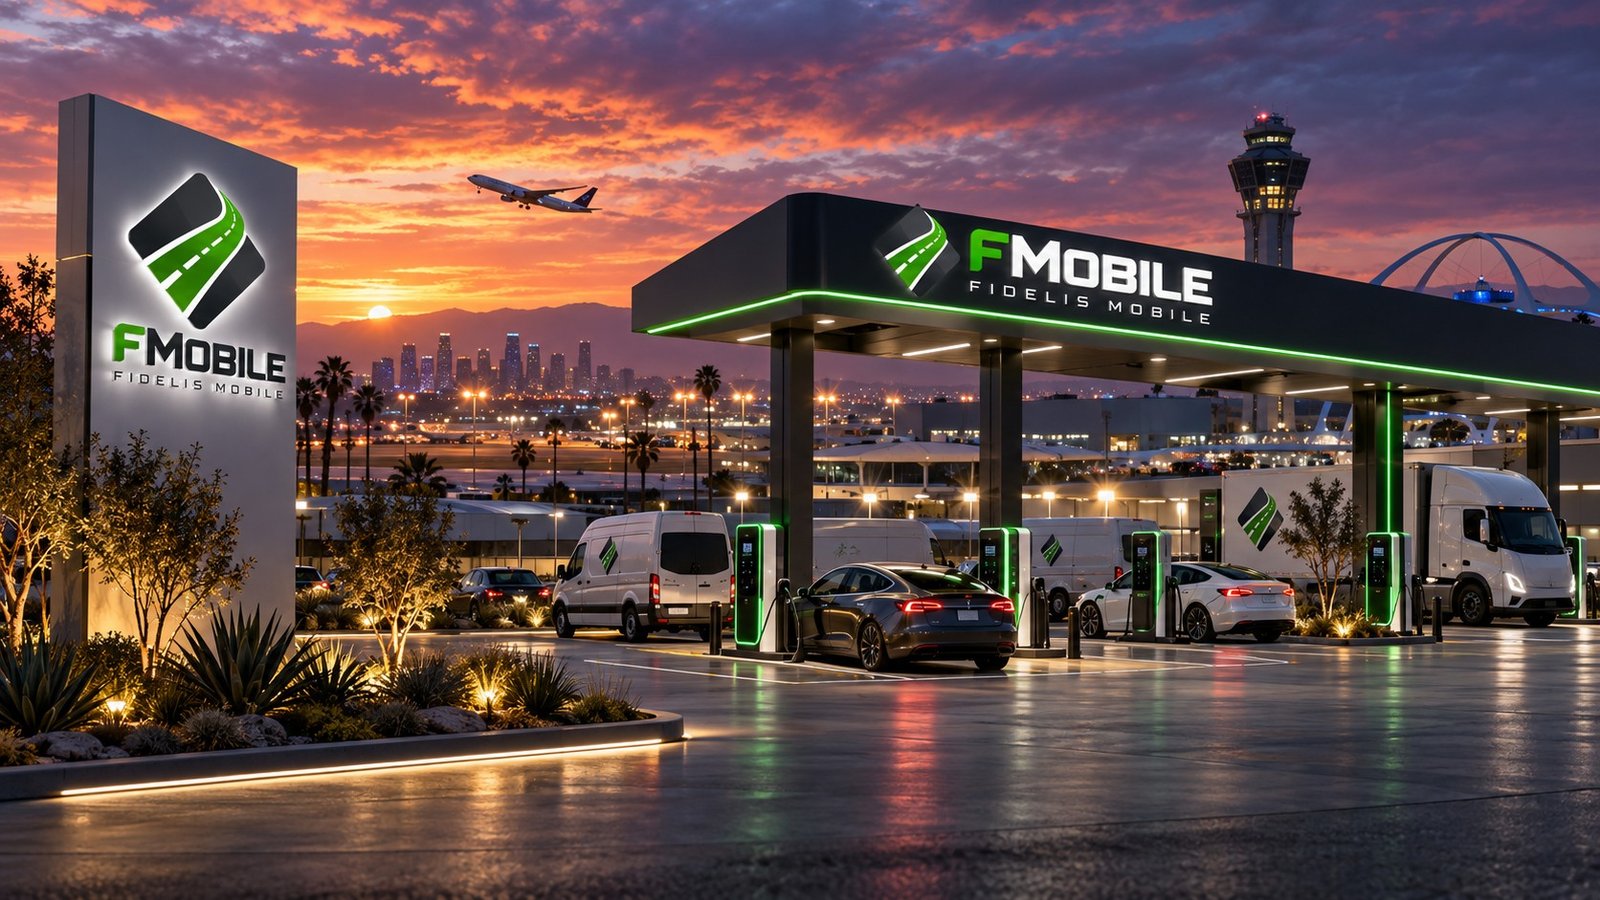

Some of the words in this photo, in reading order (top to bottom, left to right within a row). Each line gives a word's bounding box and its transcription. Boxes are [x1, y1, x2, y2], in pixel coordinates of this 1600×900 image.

[969, 228, 1213, 306] FMOBILE
[969, 280, 1089, 308] FIDELIS
[1108, 300, 1211, 325] MOBILE
[112, 323, 286, 383] FMOBILE
[113, 370, 203, 390] FIDELIS
[215, 382, 284, 400] MOBILE
